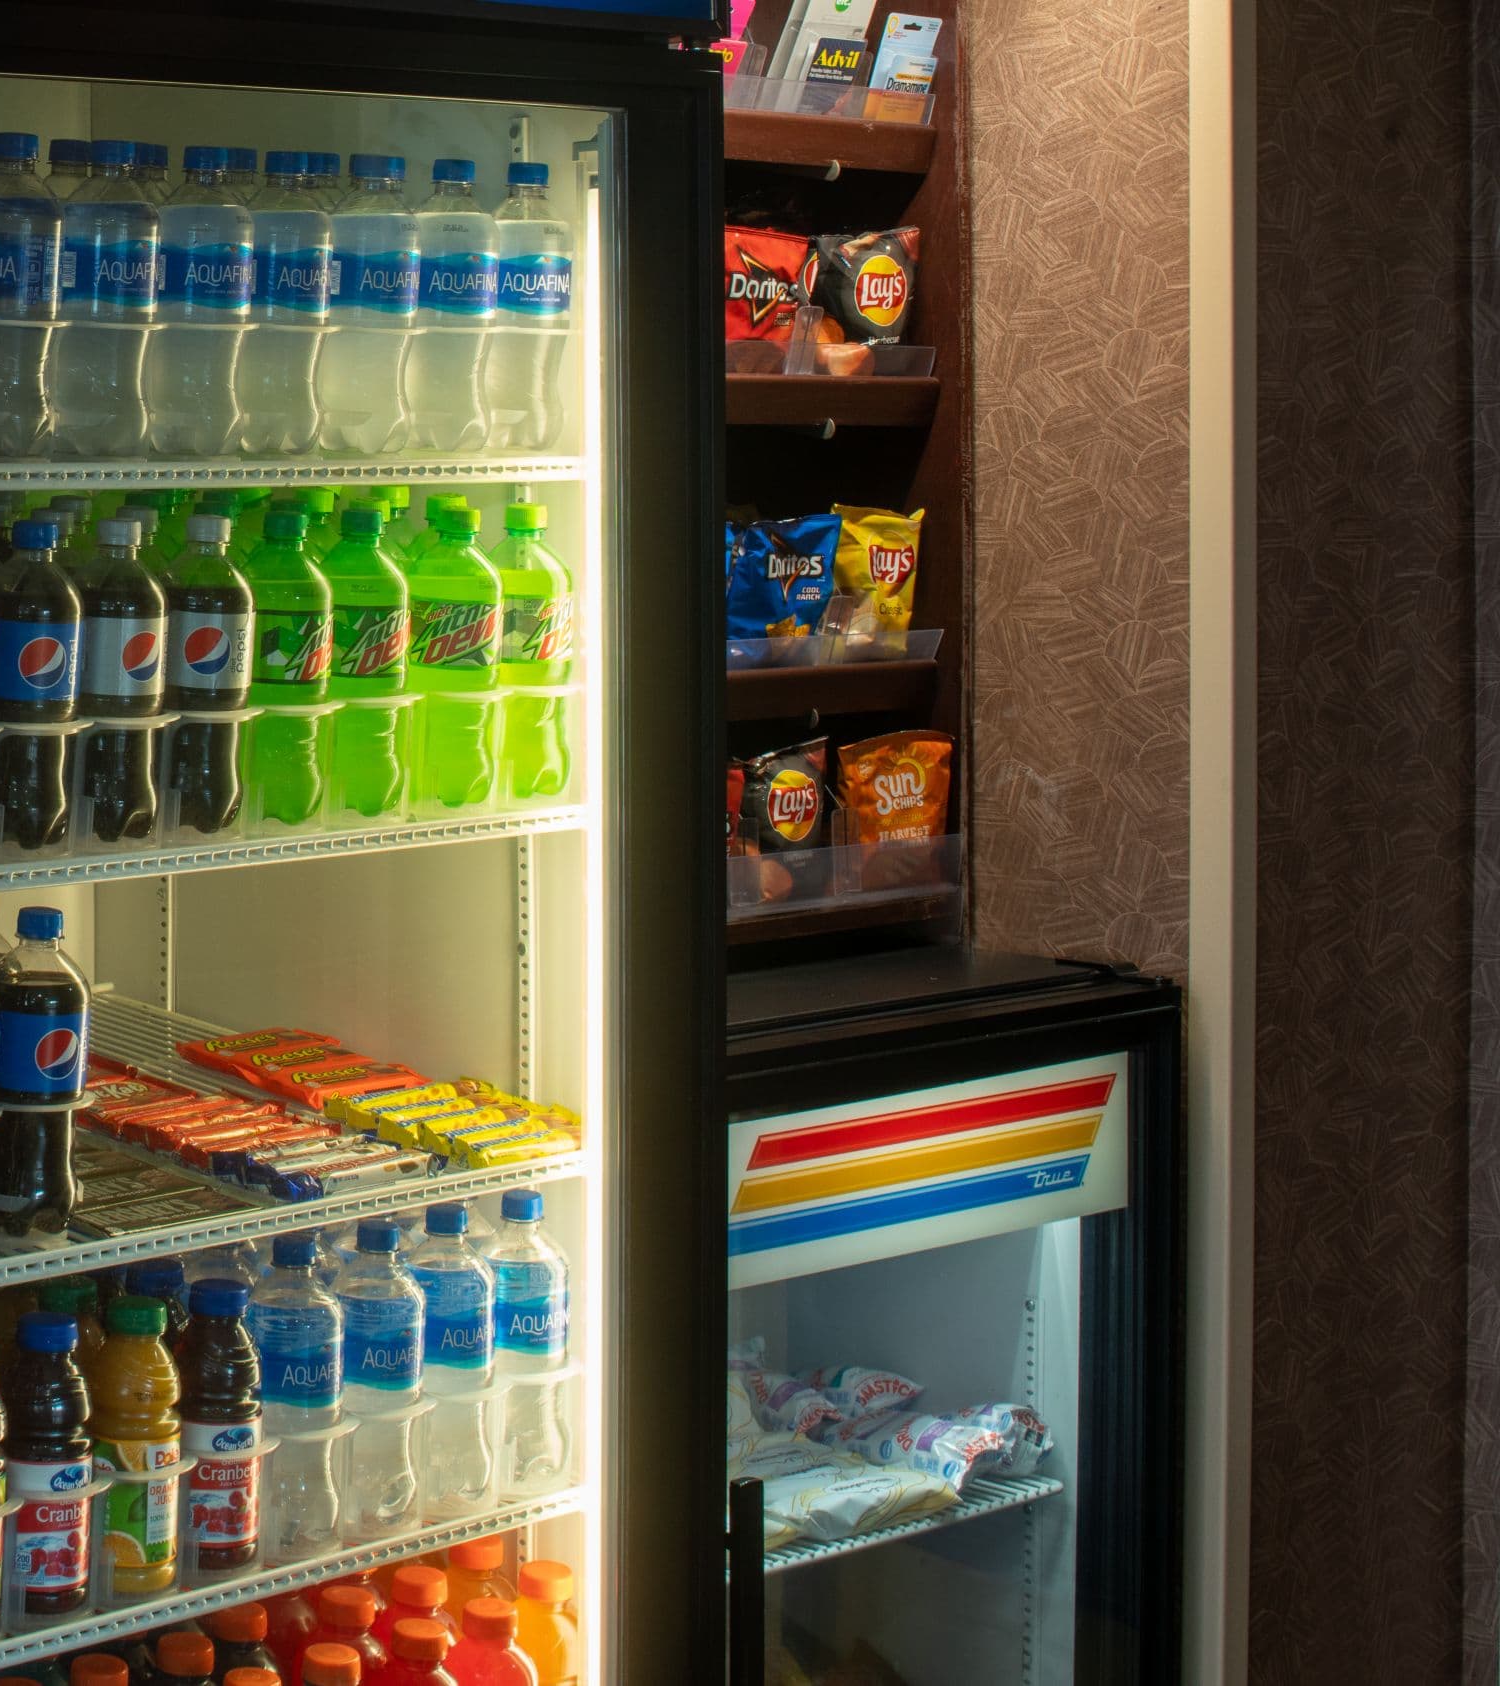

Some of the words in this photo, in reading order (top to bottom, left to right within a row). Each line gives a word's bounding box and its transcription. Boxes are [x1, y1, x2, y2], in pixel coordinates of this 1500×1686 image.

[813, 48, 861, 69] Advil
[184, 260, 250, 287] AQUAFIN
[501, 271, 571, 296] AQUAFINA
[728, 272, 798, 302] Doritos
[860, 272, 903, 310] Lay's
[767, 553, 824, 581] Doritos
[871, 546, 913, 583] Lay's
[801, 586, 821, 594] COOL
[236, 628, 247, 673] pepsi
[772, 784, 815, 825] Lay's
[874, 771, 926, 816] Sun
[893, 795, 925, 810] CHIPS
[362, 1346, 416, 1370] AQUAF
[281, 1361, 336, 1389] AQUAF
